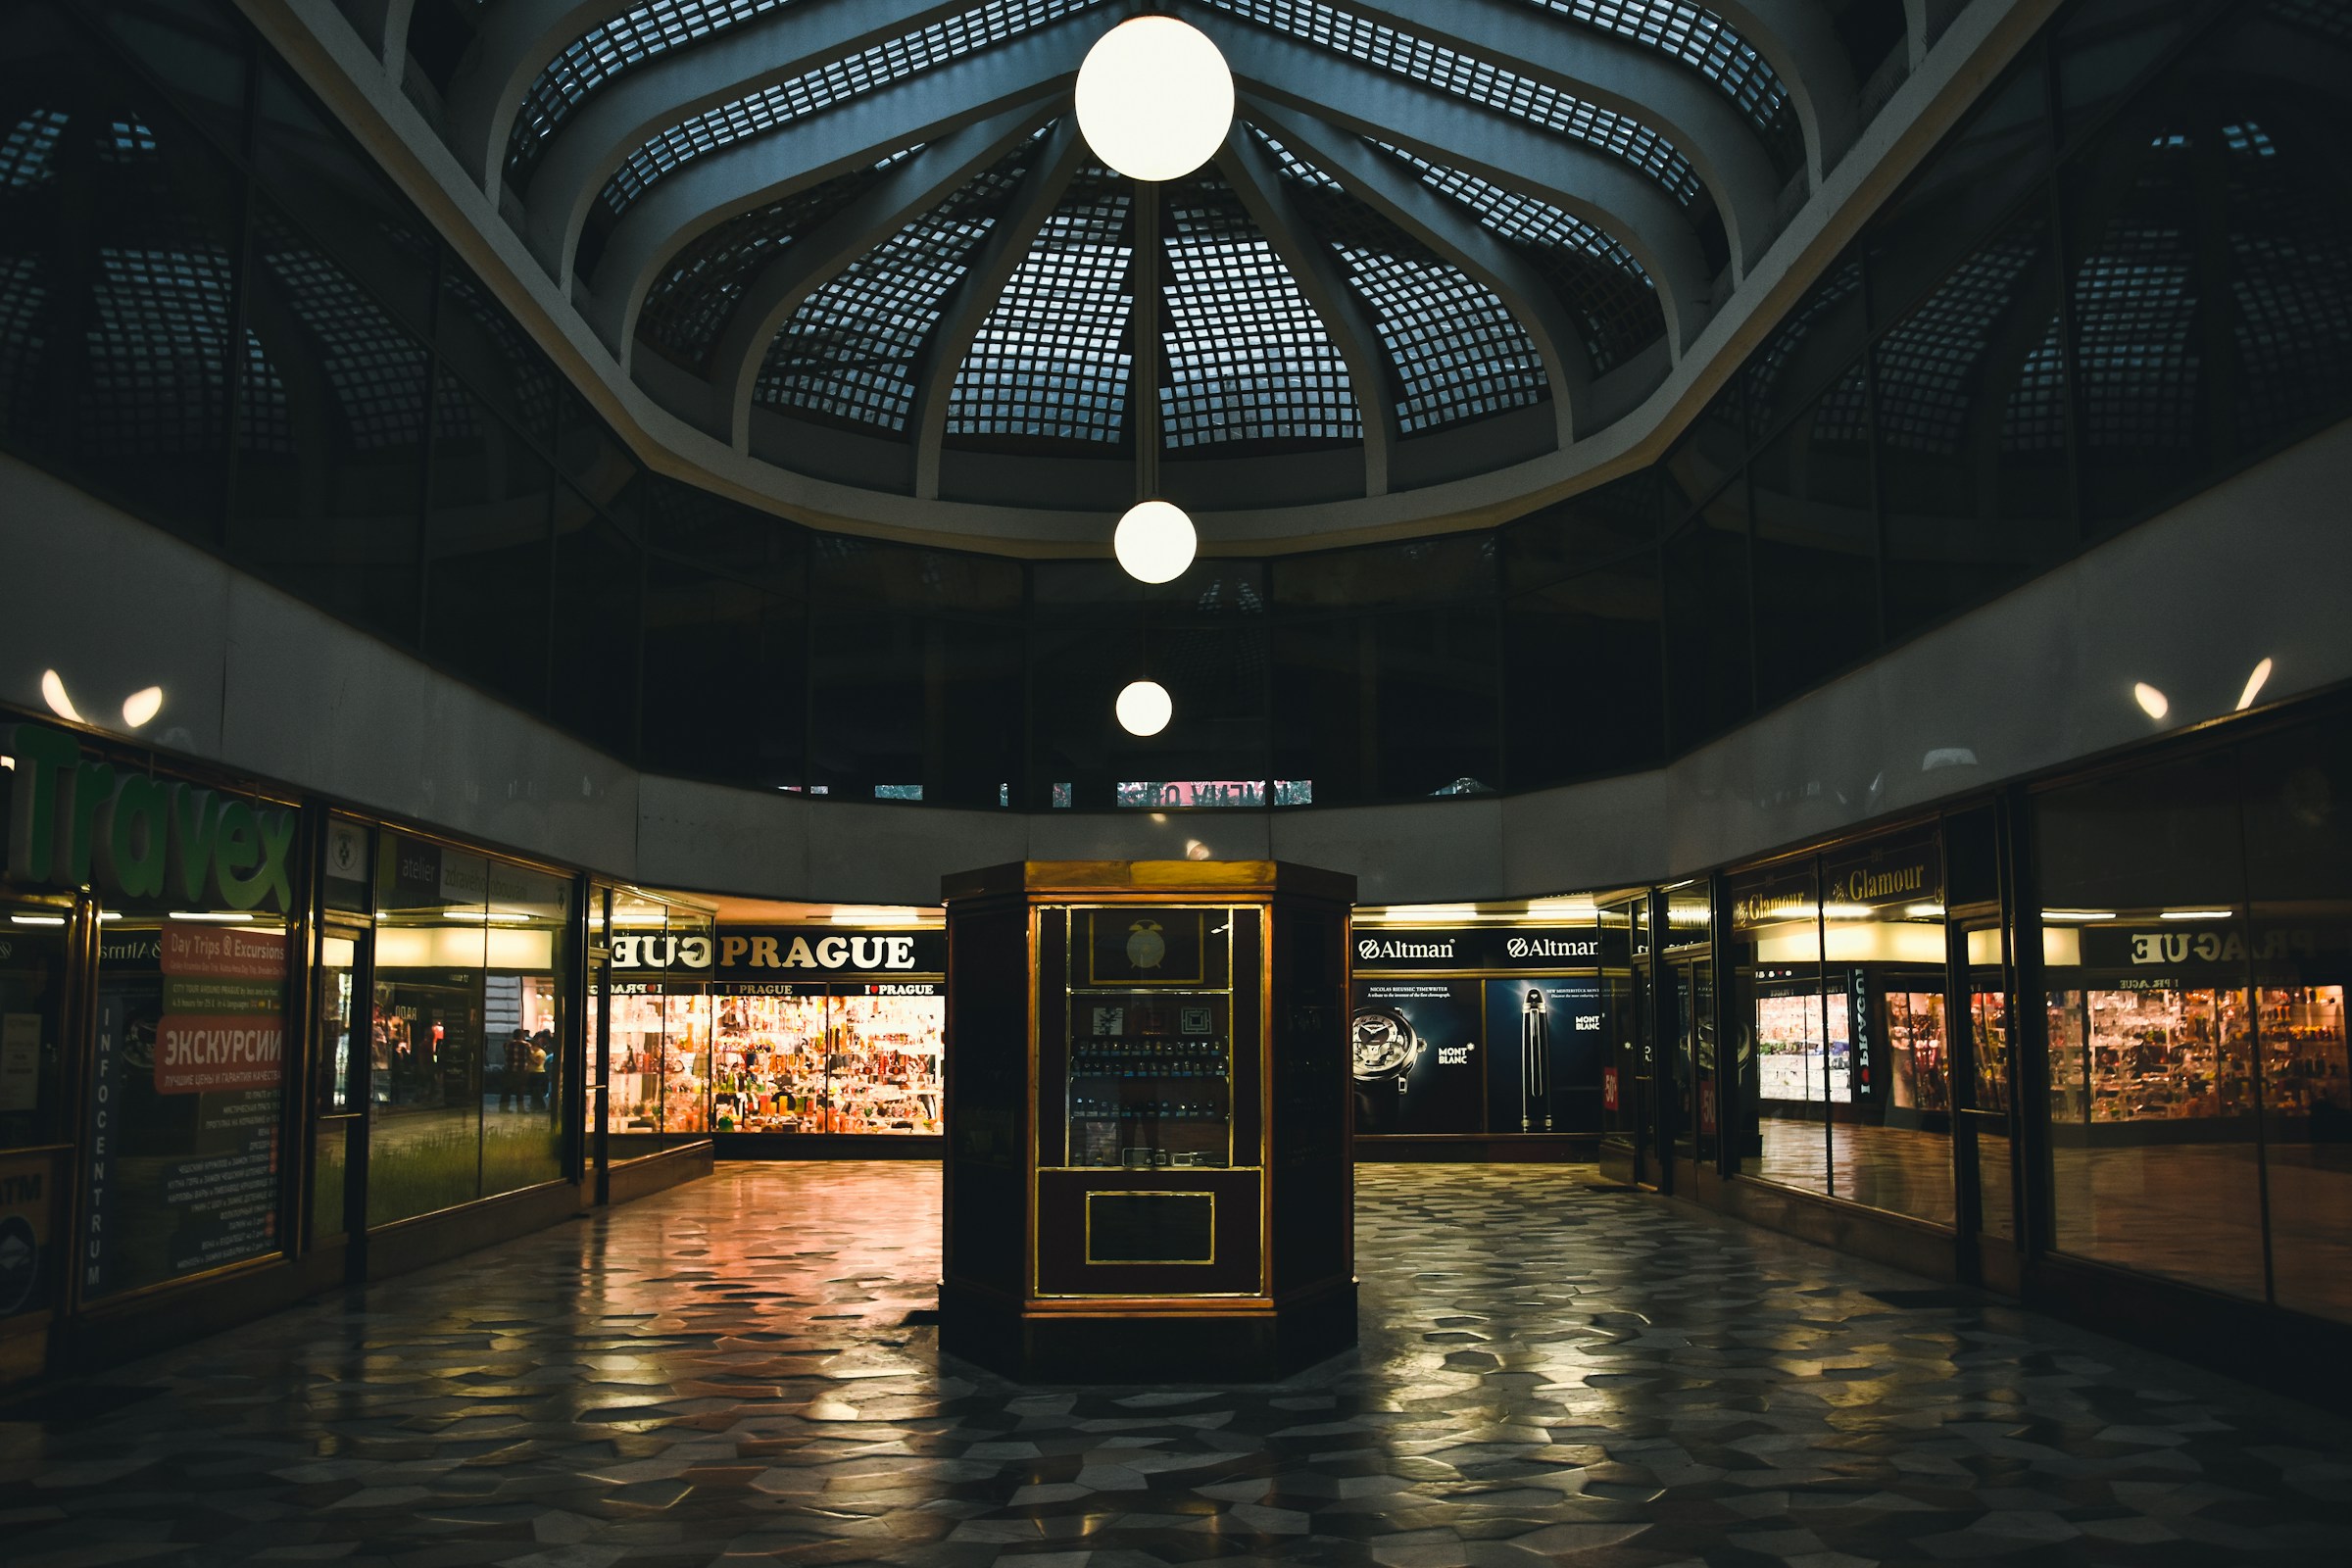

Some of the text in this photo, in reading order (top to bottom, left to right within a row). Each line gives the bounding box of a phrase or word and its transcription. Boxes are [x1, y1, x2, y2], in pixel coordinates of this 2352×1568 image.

[10, 722, 295, 913] Travex
[402, 855, 435, 883] atelier
[1849, 864, 1925, 901] Glamour
[172, 933, 191, 957] Day
[194, 935, 220, 959] Trips
[234, 939, 284, 960] Excursions
[720, 936, 915, 969] PRAGUE
[1380, 940, 1454, 958] Altman
[739, 985, 793, 995] PRAGUE
[878, 985, 934, 995] PRAGUE
[165, 1029, 283, 1065] ЭКСКУРСИИ
[1438, 1055, 1467, 1064] BLANC
[165, 1075, 194, 1087] ЛУЧШИЕ
[195, 1073, 215, 1087] ЦЕНЫ
[220, 1071, 252, 1084] ГАРАНТИЯ
[253, 1070, 281, 1082] КАЧЕСТВА
[87, 1006, 112, 1286] INFOCENTRUM
[0, 1173, 42, 1204] TM
